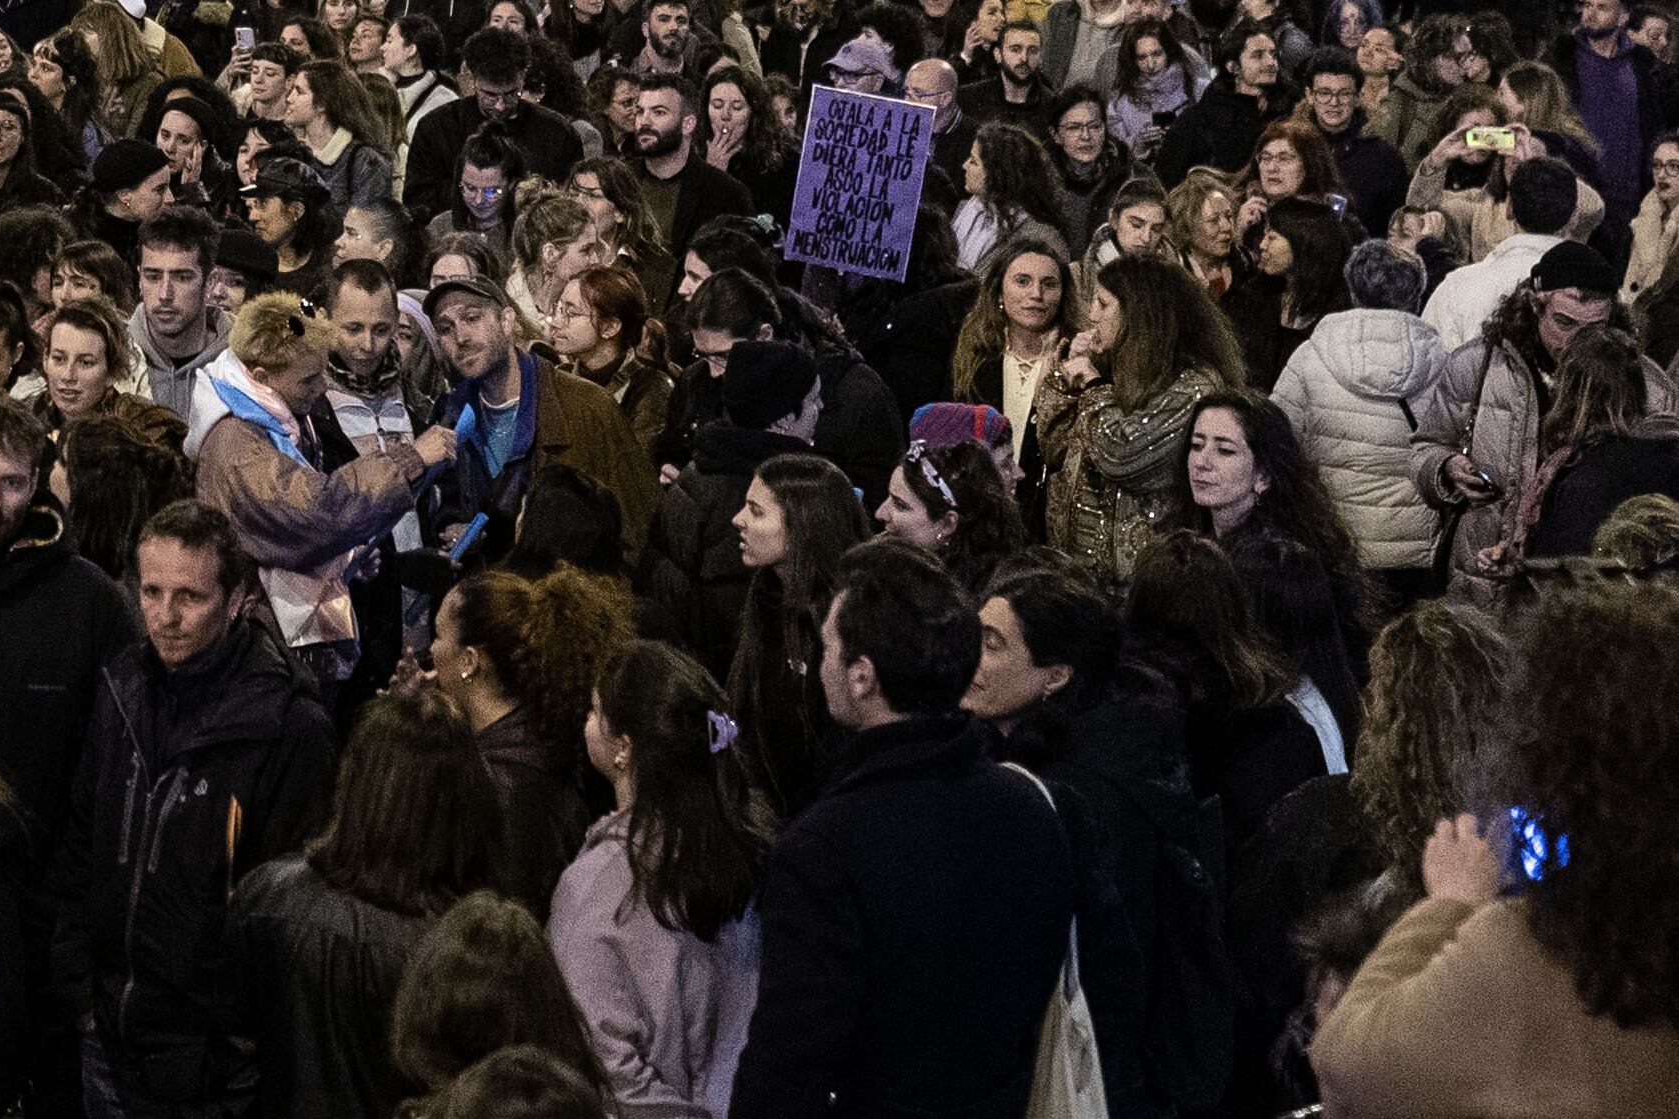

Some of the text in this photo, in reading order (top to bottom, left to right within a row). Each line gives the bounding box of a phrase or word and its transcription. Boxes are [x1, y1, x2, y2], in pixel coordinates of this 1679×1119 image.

[815, 117, 918, 159] SOCIEDAD LE
[883, 110, 892, 131] A
[901, 113, 921, 136] LA
[813, 143, 913, 181] DIERA TANTO
[824, 167, 889, 200] ASCO LA
[816, 212, 883, 246] COMO LA
